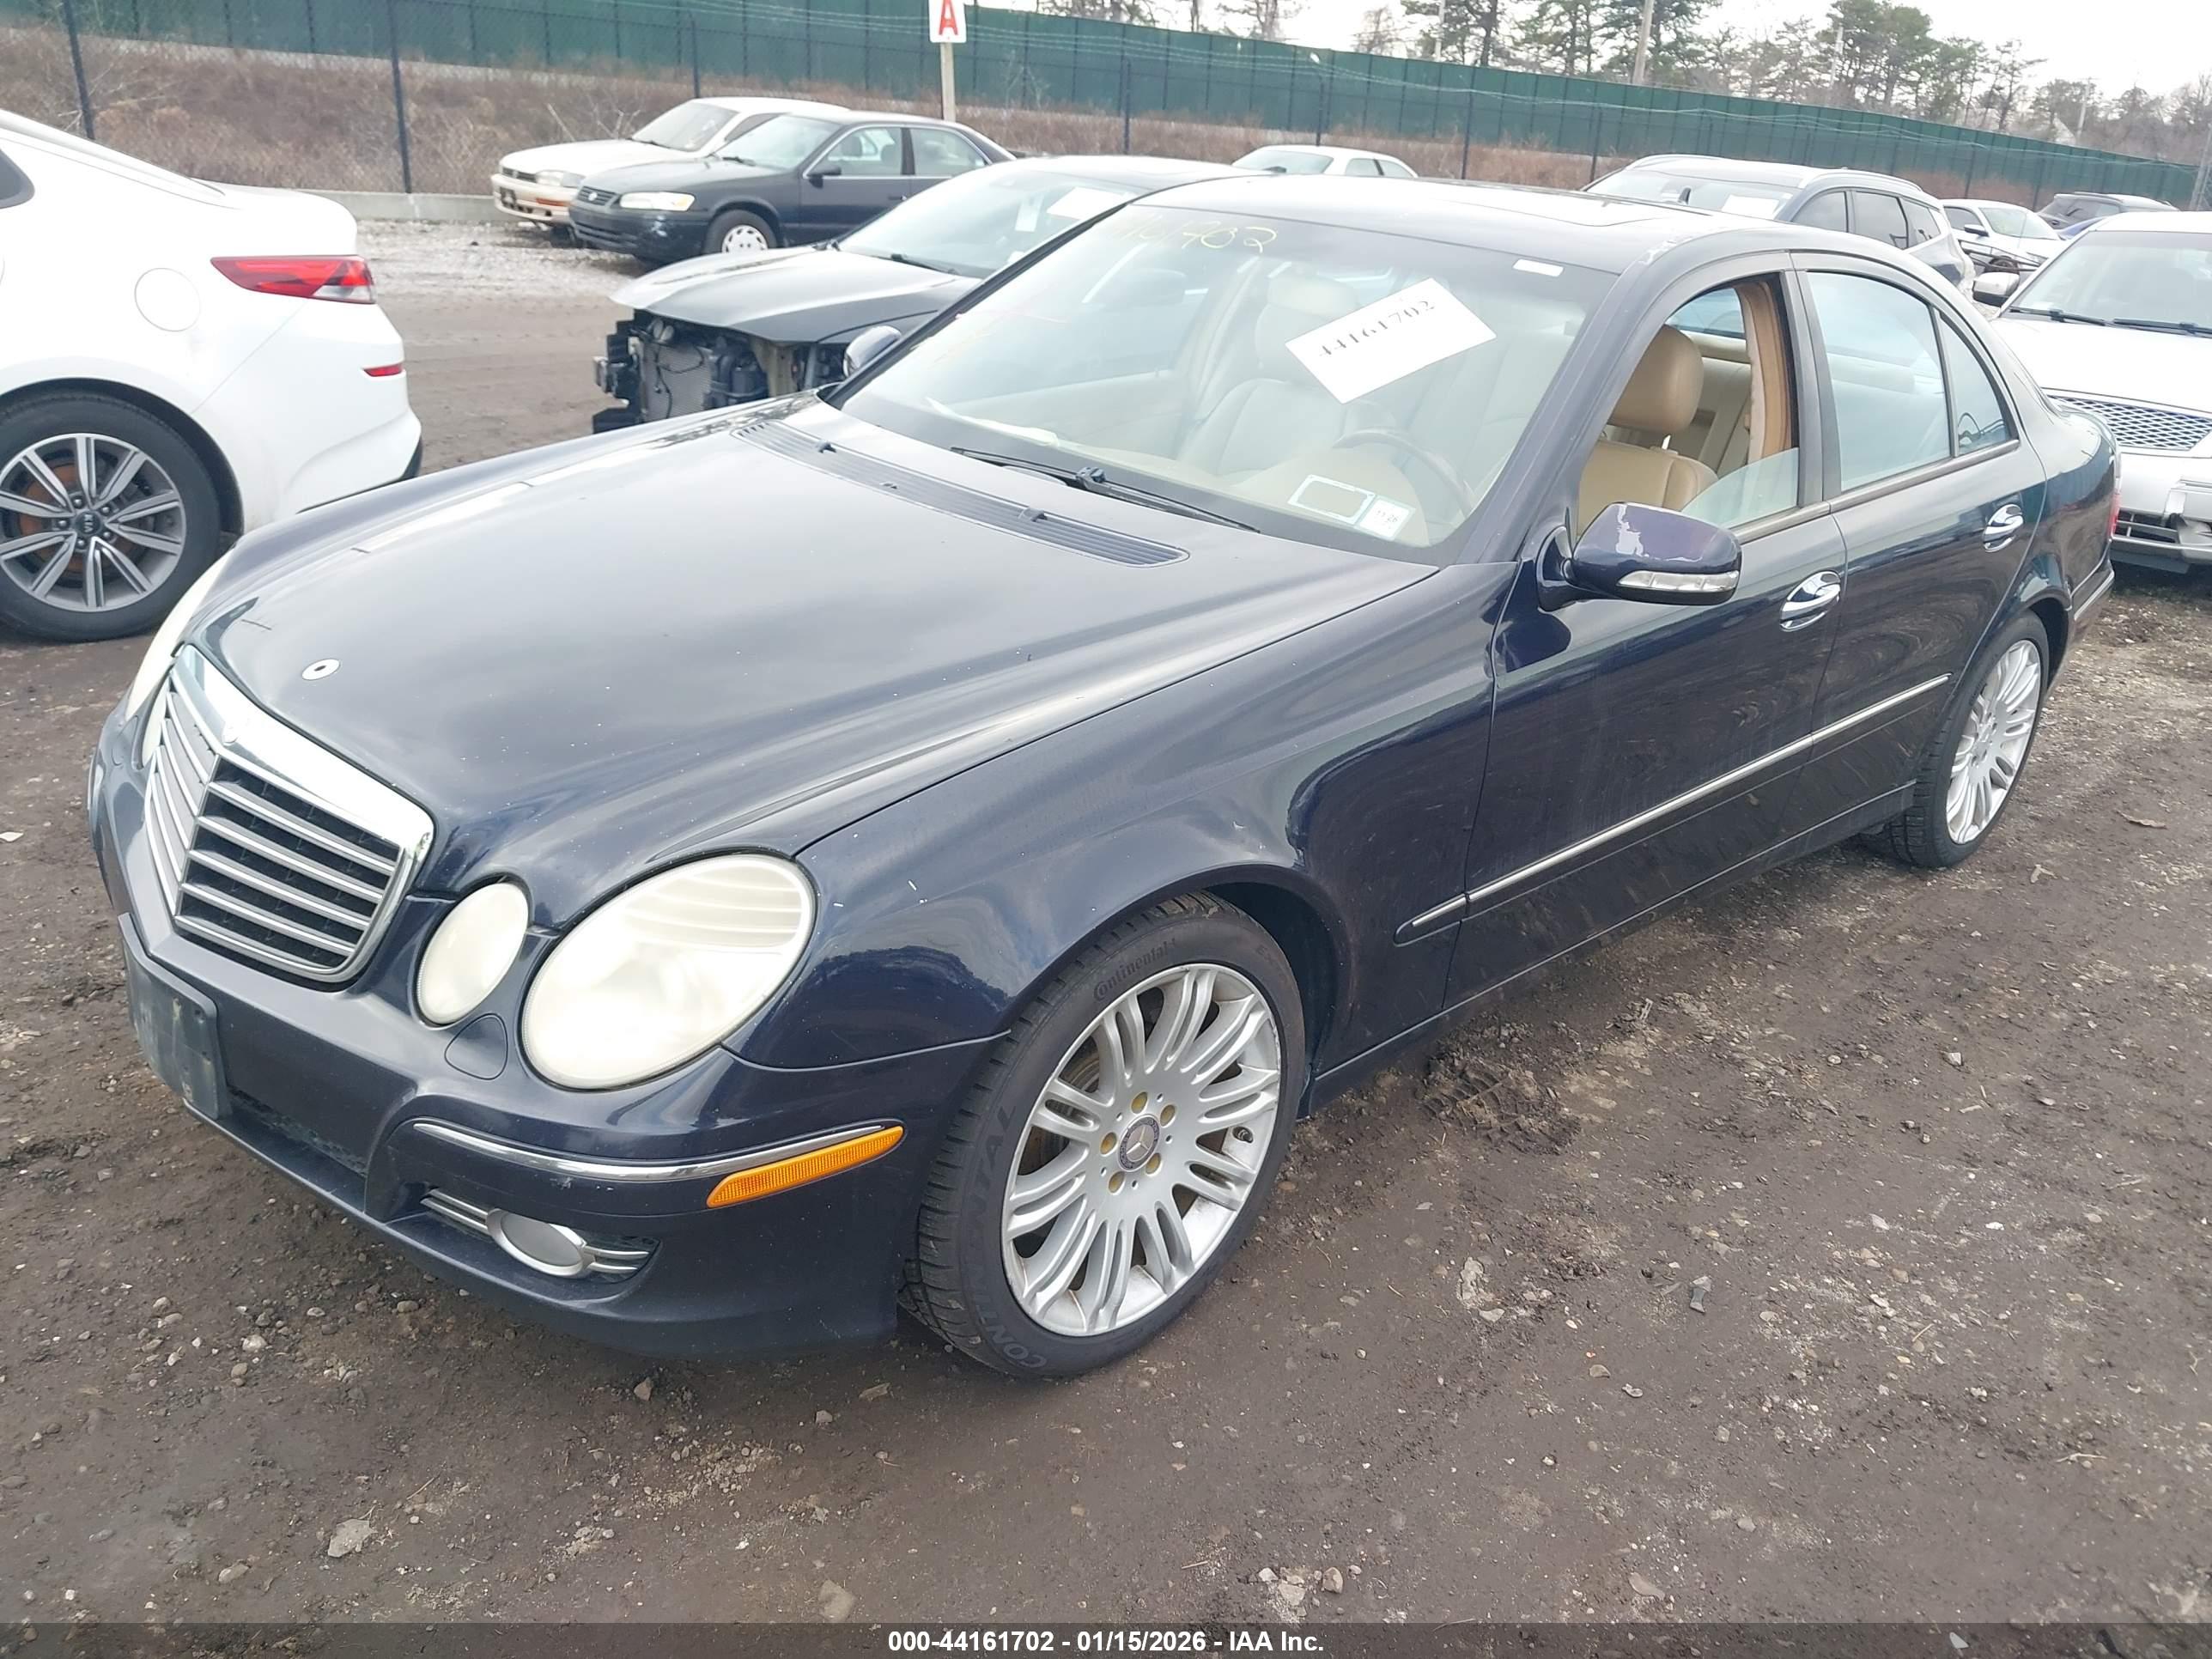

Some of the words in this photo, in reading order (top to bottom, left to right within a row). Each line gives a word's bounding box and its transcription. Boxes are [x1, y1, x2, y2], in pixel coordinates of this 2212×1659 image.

[938, 0, 958, 35] A
[1320, 301, 1435, 356] 44161702
[1093, 940, 1169, 1001] Continental
